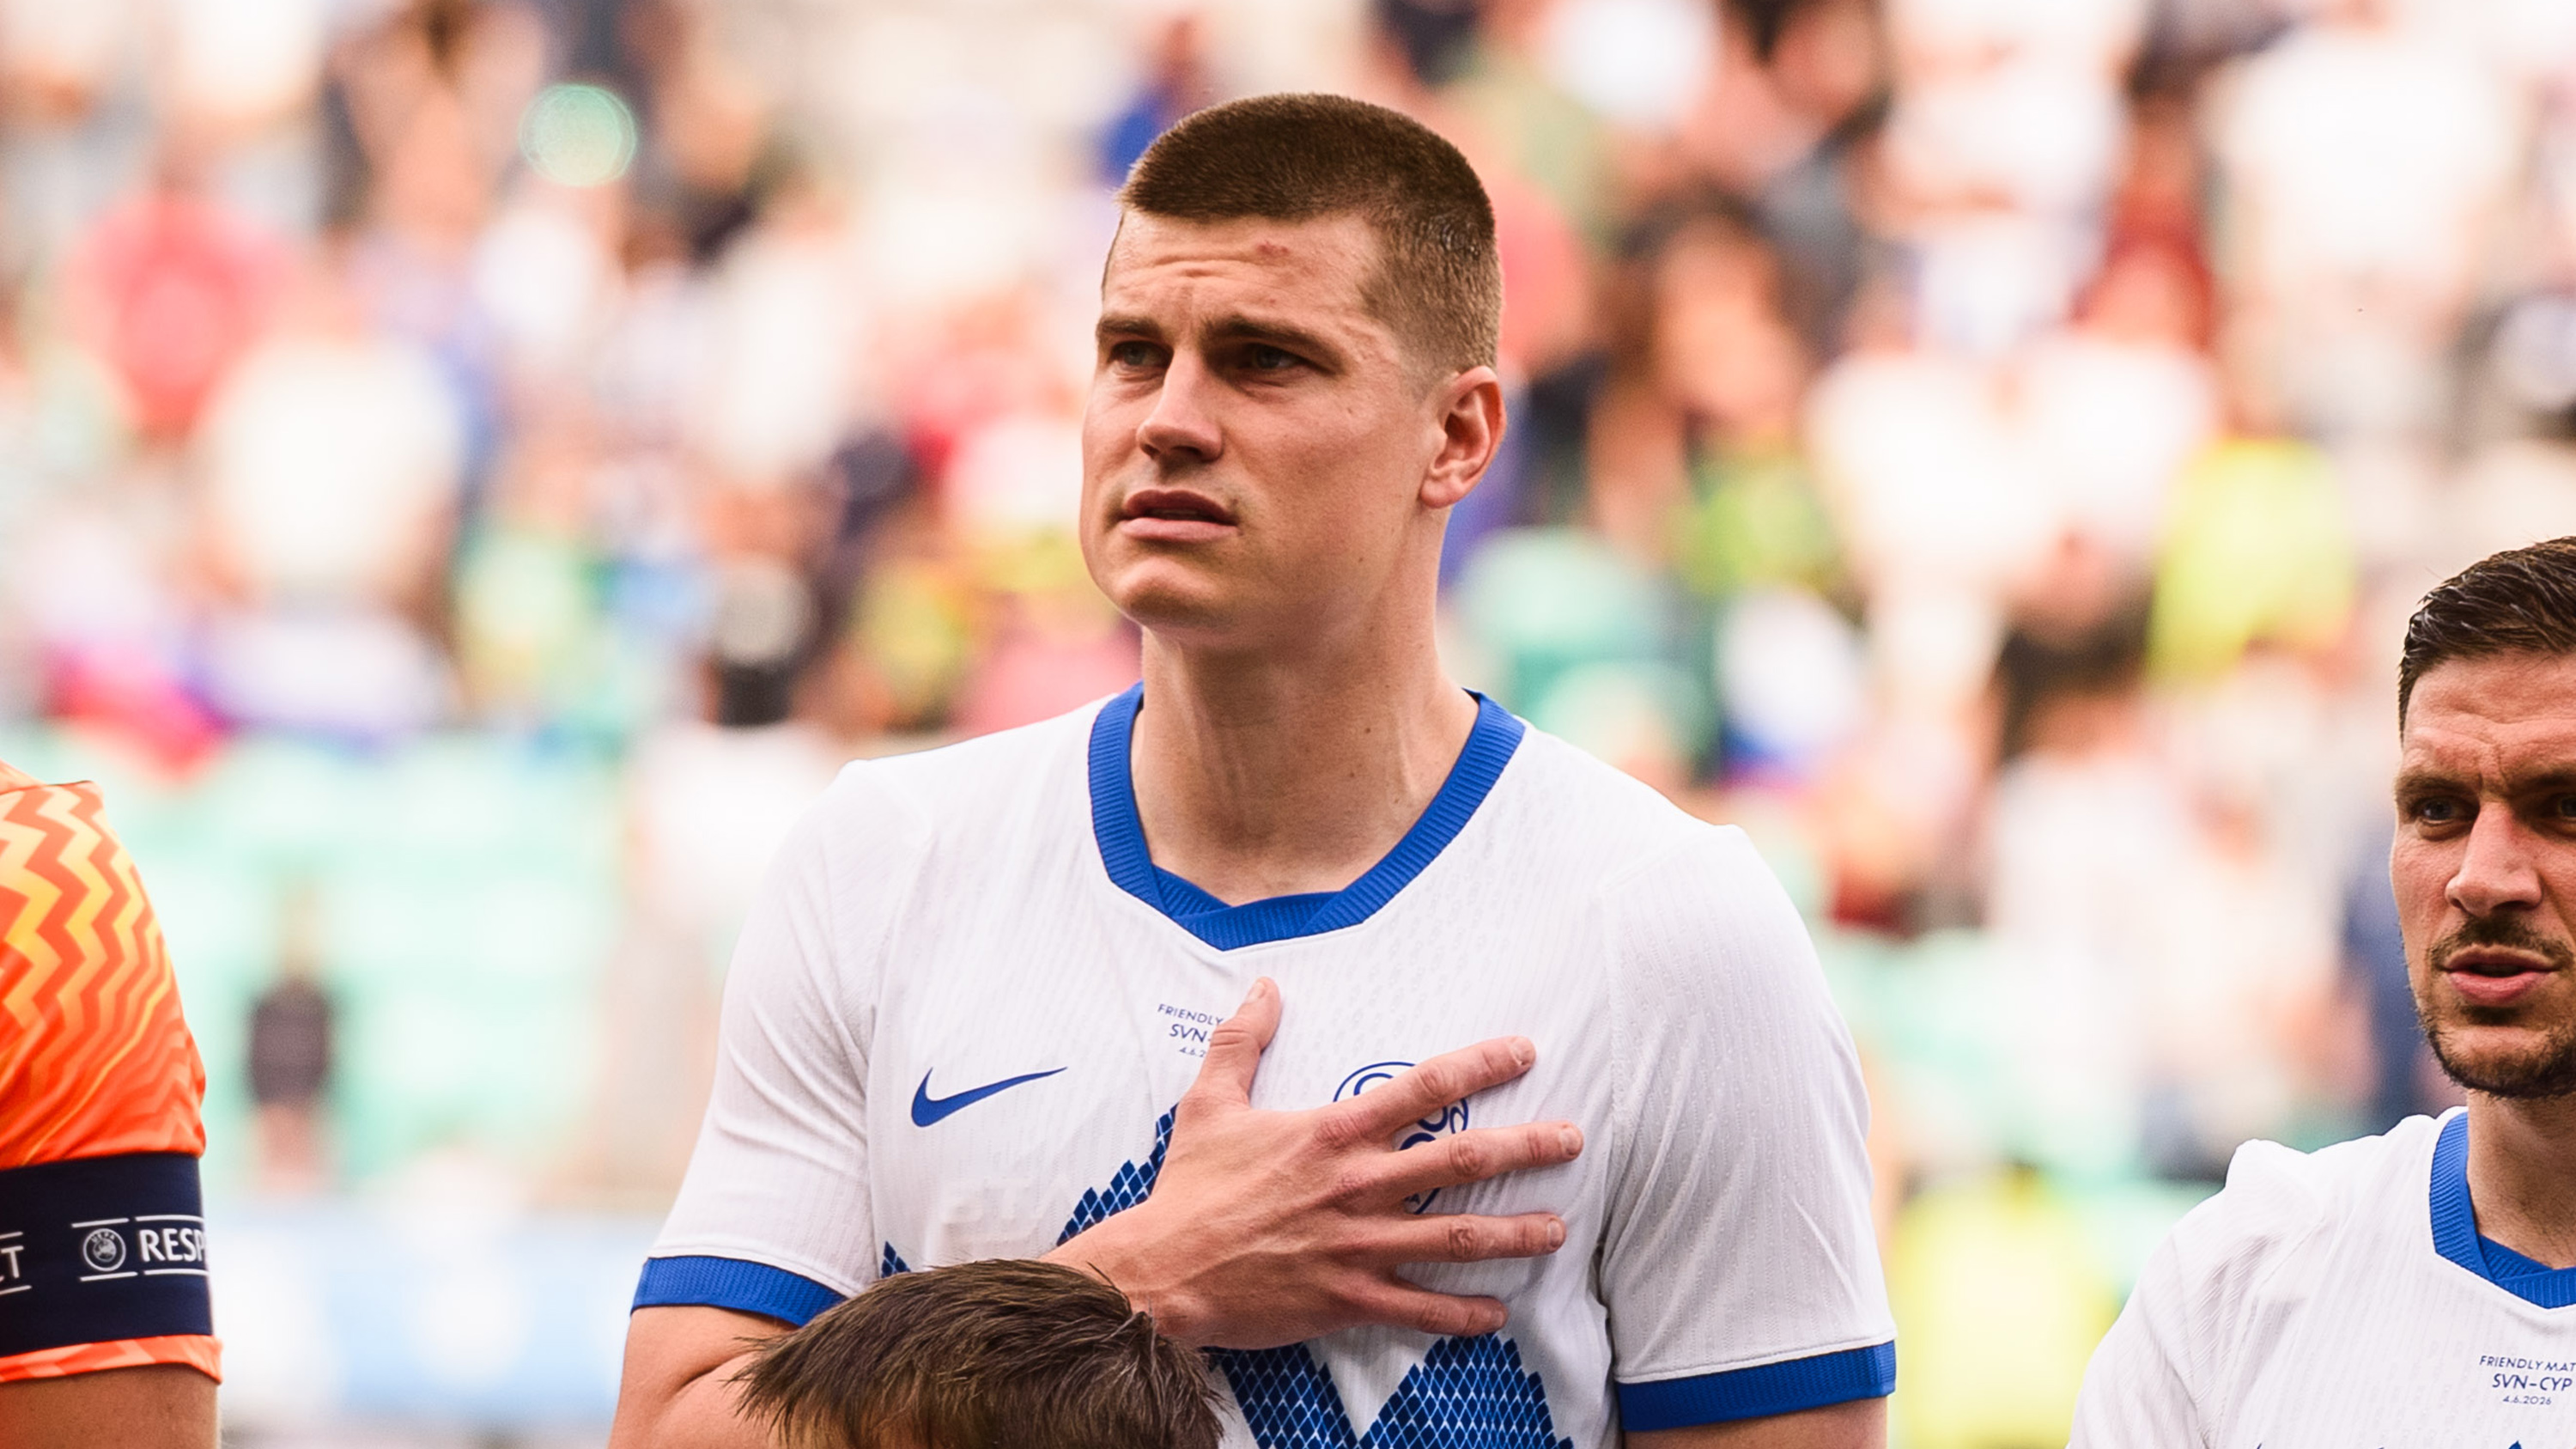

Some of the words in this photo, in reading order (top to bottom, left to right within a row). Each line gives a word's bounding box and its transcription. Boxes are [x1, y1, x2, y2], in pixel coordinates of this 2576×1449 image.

[1157, 1003, 1224, 1026] FRIENDLY
[2479, 1355, 2543, 1370] FRIENDLY
[2492, 1373, 2573, 1391] SVN-CYP
[2502, 1395, 2552, 1405] 4.6.2026
